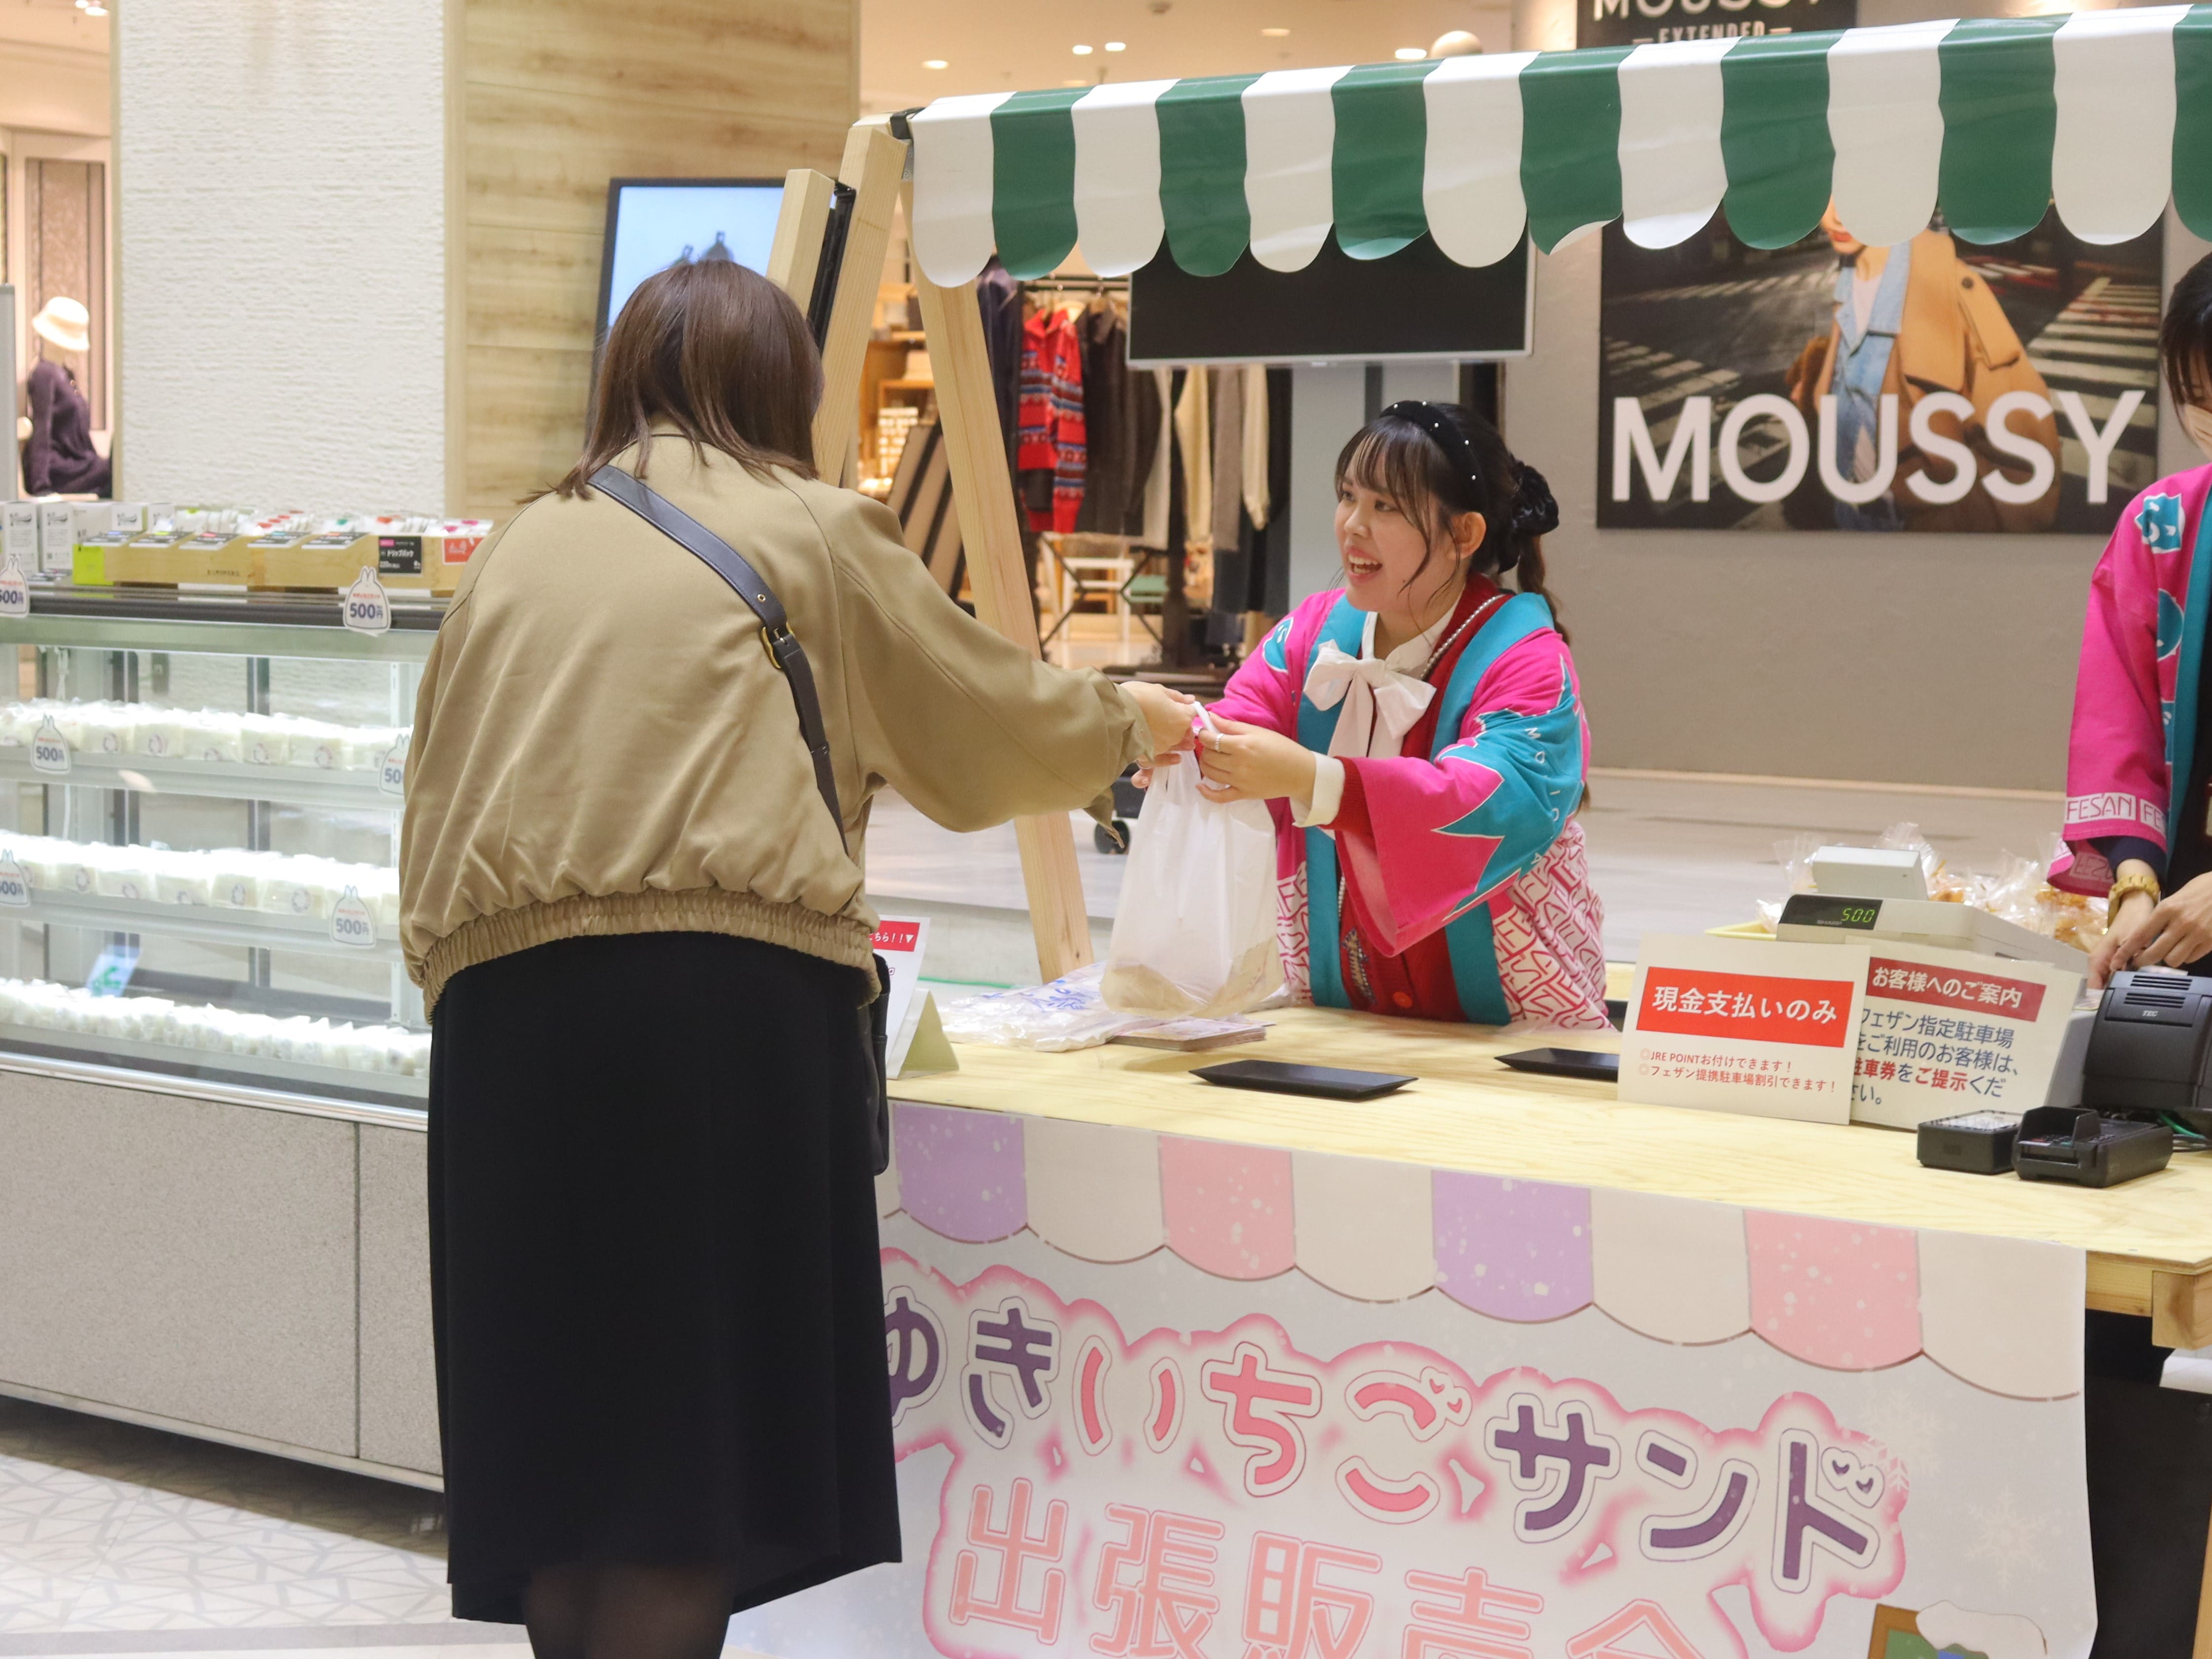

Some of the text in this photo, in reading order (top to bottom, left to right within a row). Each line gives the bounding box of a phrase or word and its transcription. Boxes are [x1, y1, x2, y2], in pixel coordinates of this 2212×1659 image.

[1612, 390, 2147, 504] MOUSSY
[384, 767, 404, 785] 50
[2066, 793, 2133, 821] FESAN
[2144, 803, 2166, 830] FE
[1840, 907, 1875, 923] 500
[1872, 966, 2023, 1009] お客様へのご案内
[1651, 986, 1837, 1024] 現金支払いのみ
[1861, 1008, 2015, 1049] フェザン指定駐車場
[1650, 1051, 1667, 1061] JRE
[1650, 1065, 1835, 1093] フェザン提携駐車場割引できます！
[885, 1293, 1881, 1582] ゆきいちごサンド
